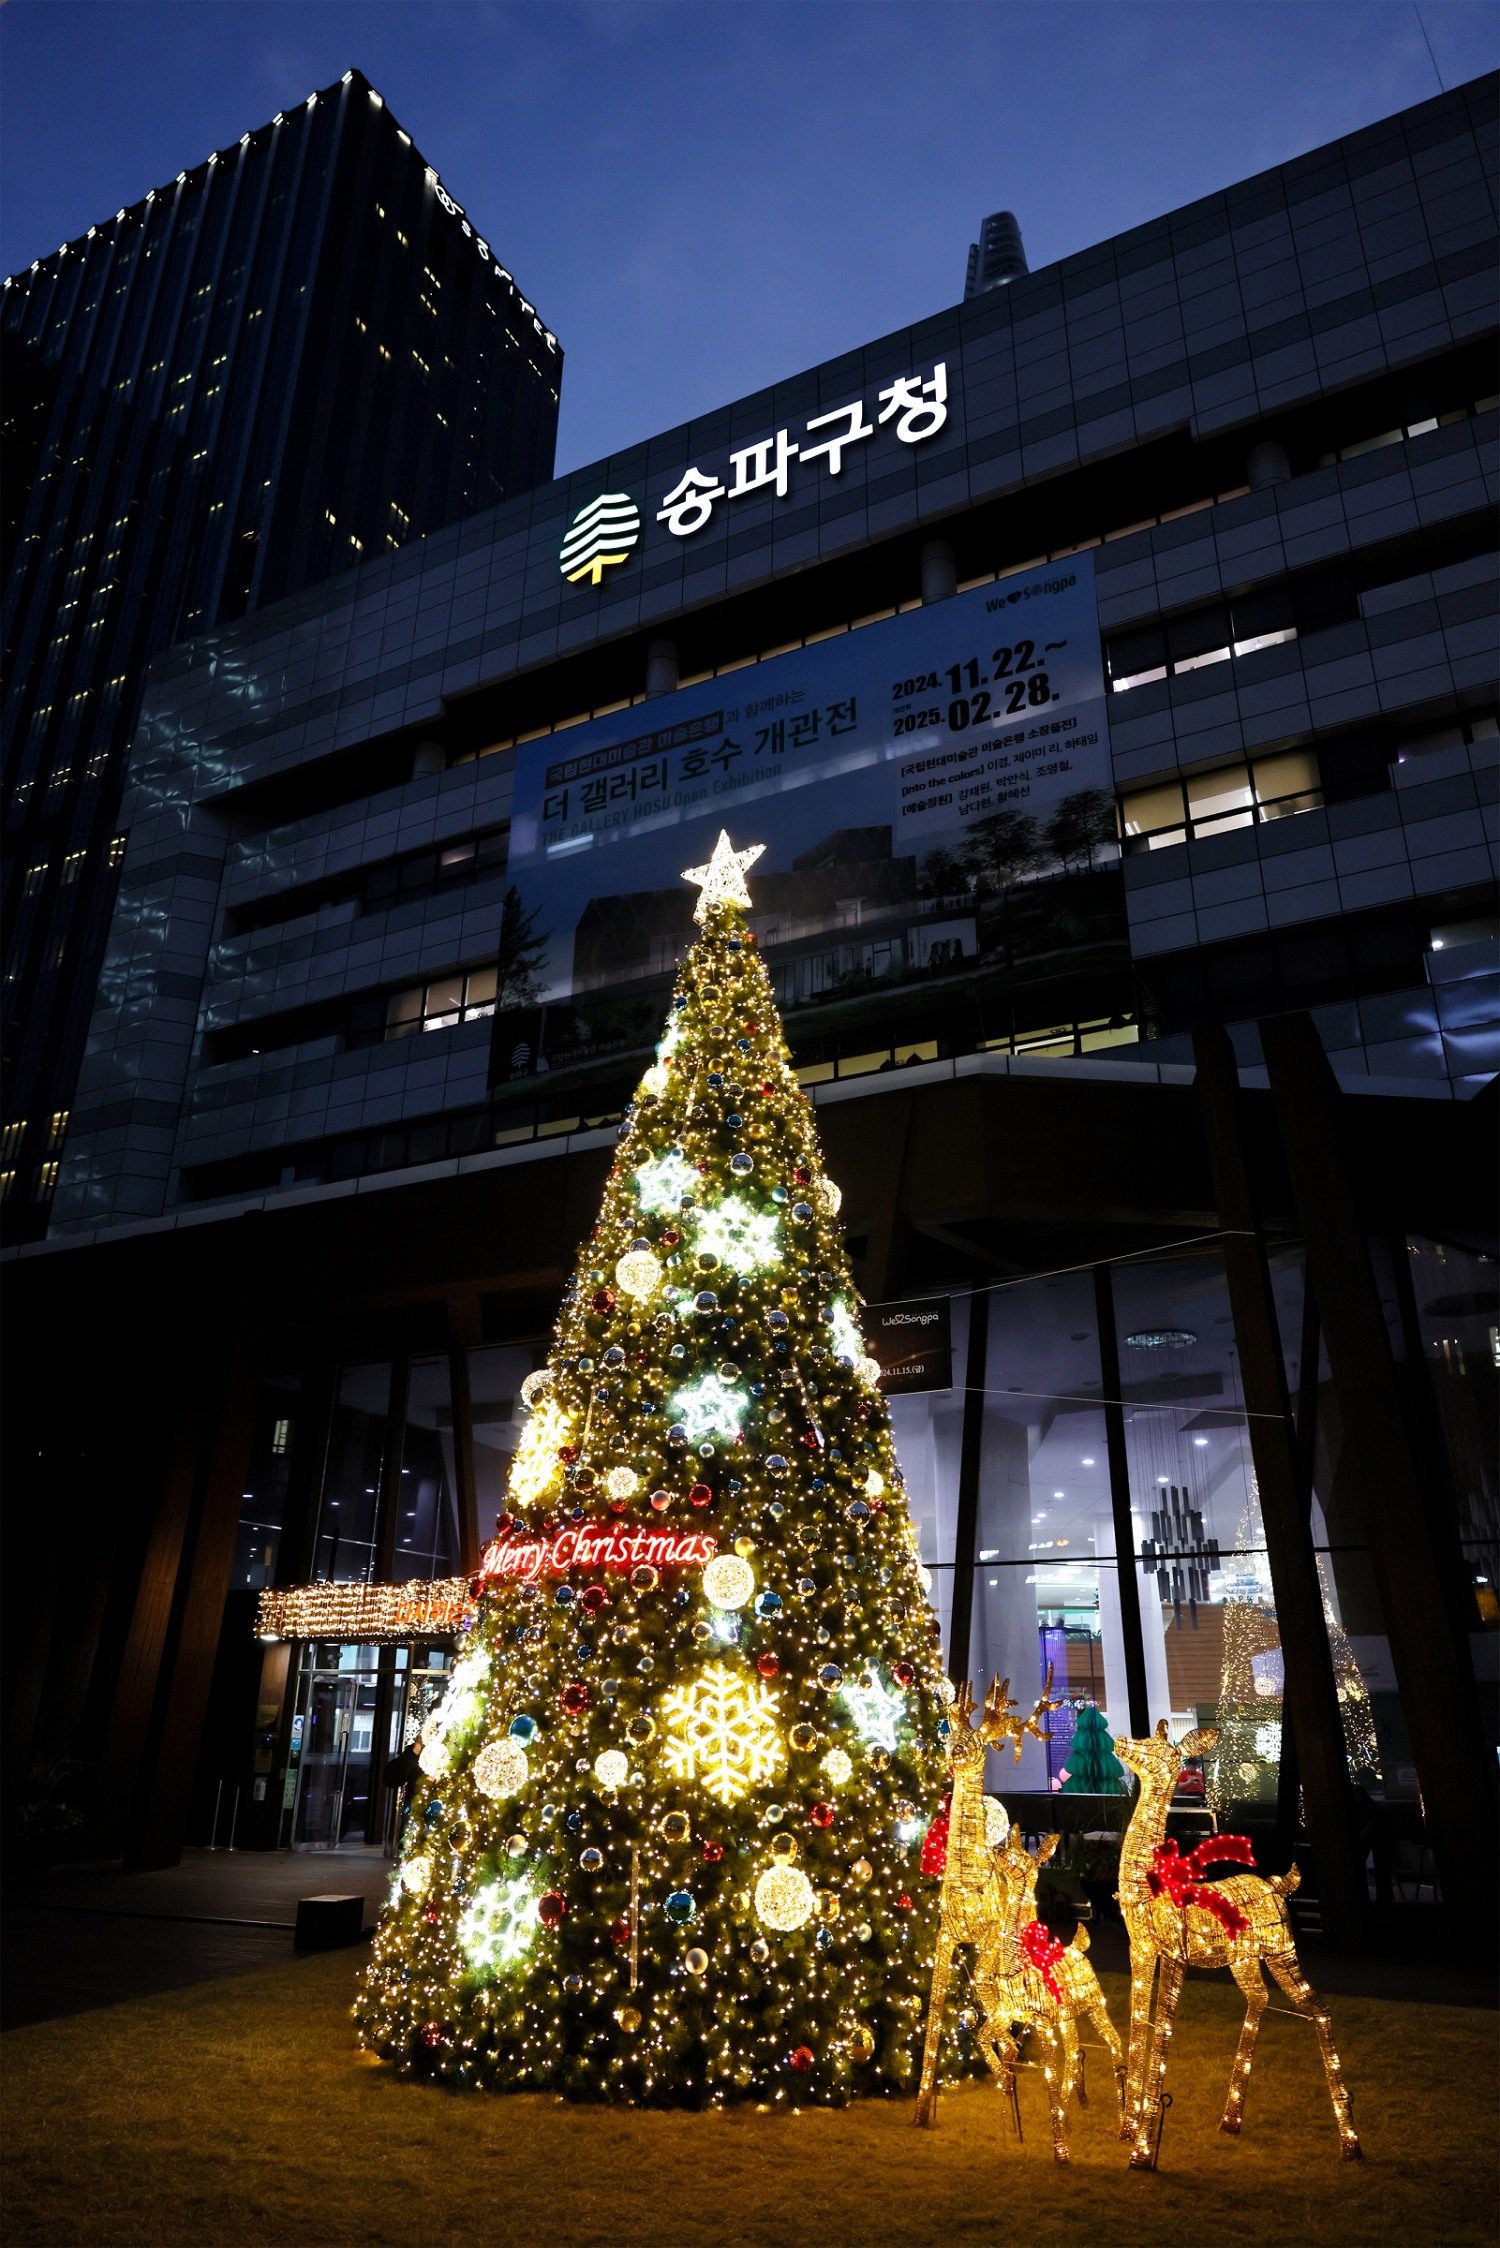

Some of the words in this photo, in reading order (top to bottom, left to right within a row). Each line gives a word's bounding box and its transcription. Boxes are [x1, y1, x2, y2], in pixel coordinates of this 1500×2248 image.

[656, 362, 948, 537] 송파구청
[745, 689, 805, 719] 함께하는
[543, 789, 569, 821] 더
[579, 757, 667, 815] 갤러리
[678, 737, 743, 782] 호수
[754, 697, 857, 755] 개관전
[981, 732, 1025, 752] 미술은행
[1064, 733, 1099, 749] 하태임
[902, 782, 926, 797] [into
[928, 778, 946, 788] the
[948, 764, 985, 783] colors]
[542, 827, 566, 848] THE
[571, 810, 629, 838] GALLERY
[634, 795, 671, 819] HOSU
[674, 786, 707, 807] Open
[713, 764, 781, 795] Exhibition
[480, 1536, 547, 1581] Merry
[551, 1524, 719, 1569] Christmas
